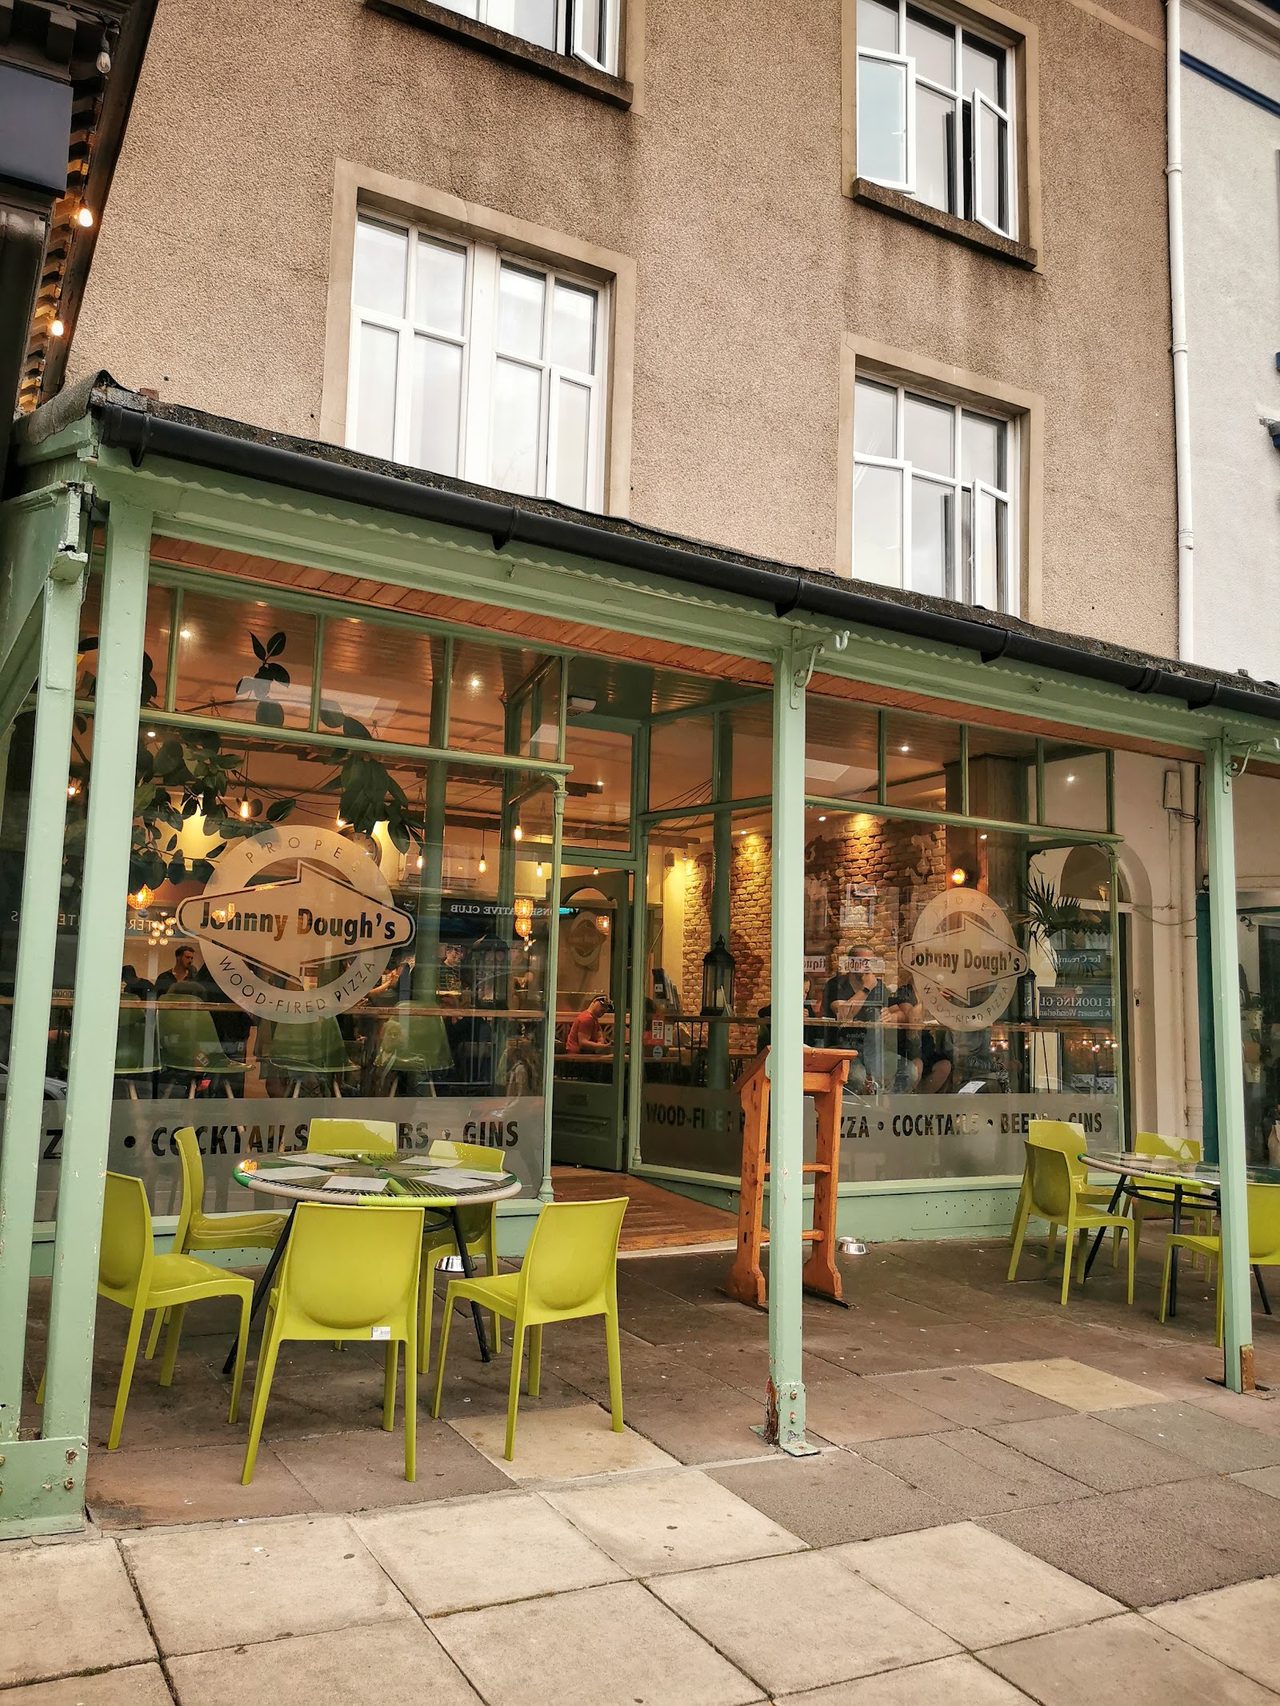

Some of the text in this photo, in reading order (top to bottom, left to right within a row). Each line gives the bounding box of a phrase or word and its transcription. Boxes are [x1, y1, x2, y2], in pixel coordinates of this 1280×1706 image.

[245, 836, 361, 872] PROPE
[200, 901, 396, 946] Johnny Dough's
[910, 946, 1020, 976] Johnny Dough's
[219, 955, 376, 1015] WOOD-FIRED PIZZA
[462, 1120, 519, 1148] GINS
